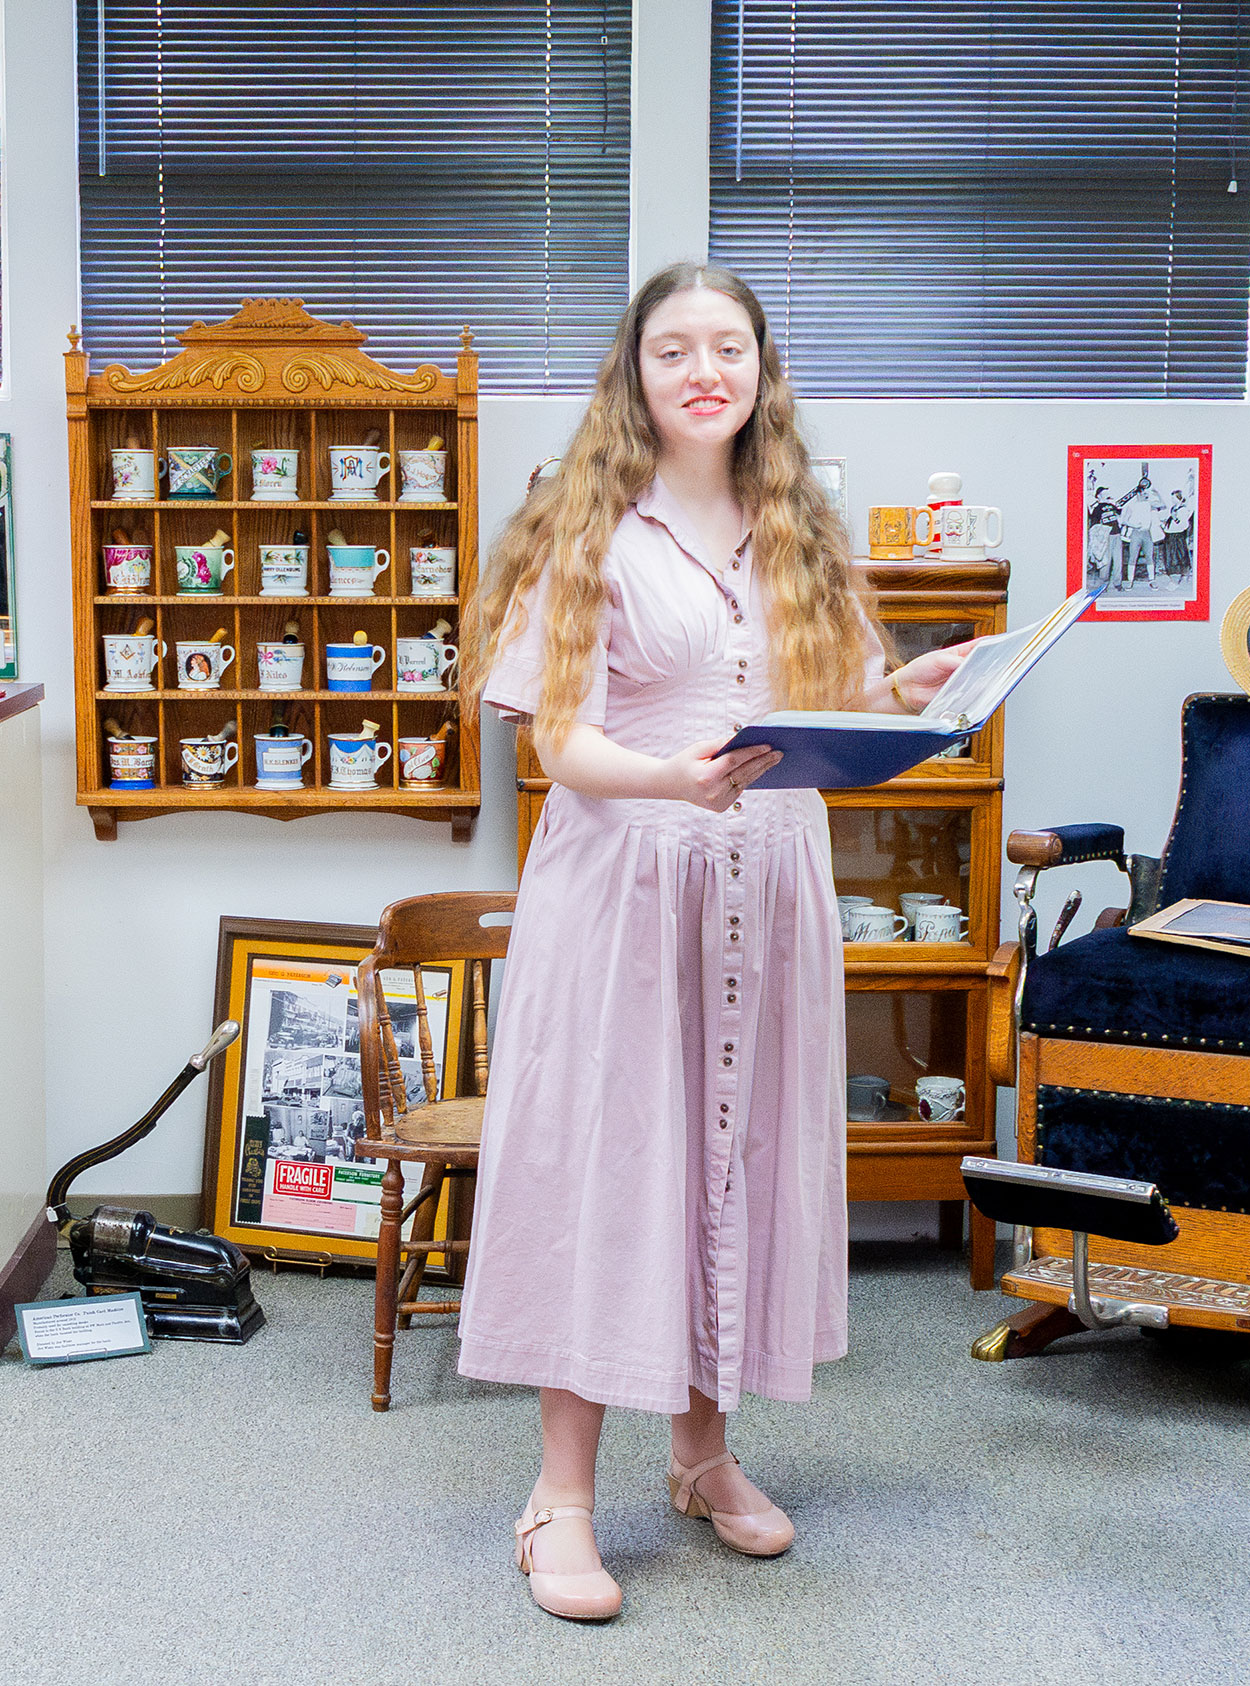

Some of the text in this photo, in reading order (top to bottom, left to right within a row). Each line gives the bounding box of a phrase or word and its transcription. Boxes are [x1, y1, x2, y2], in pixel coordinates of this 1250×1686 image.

[279, 1165, 329, 1188] FRAGILE
[279, 1183, 325, 1194] HANDLE WITH CARE
